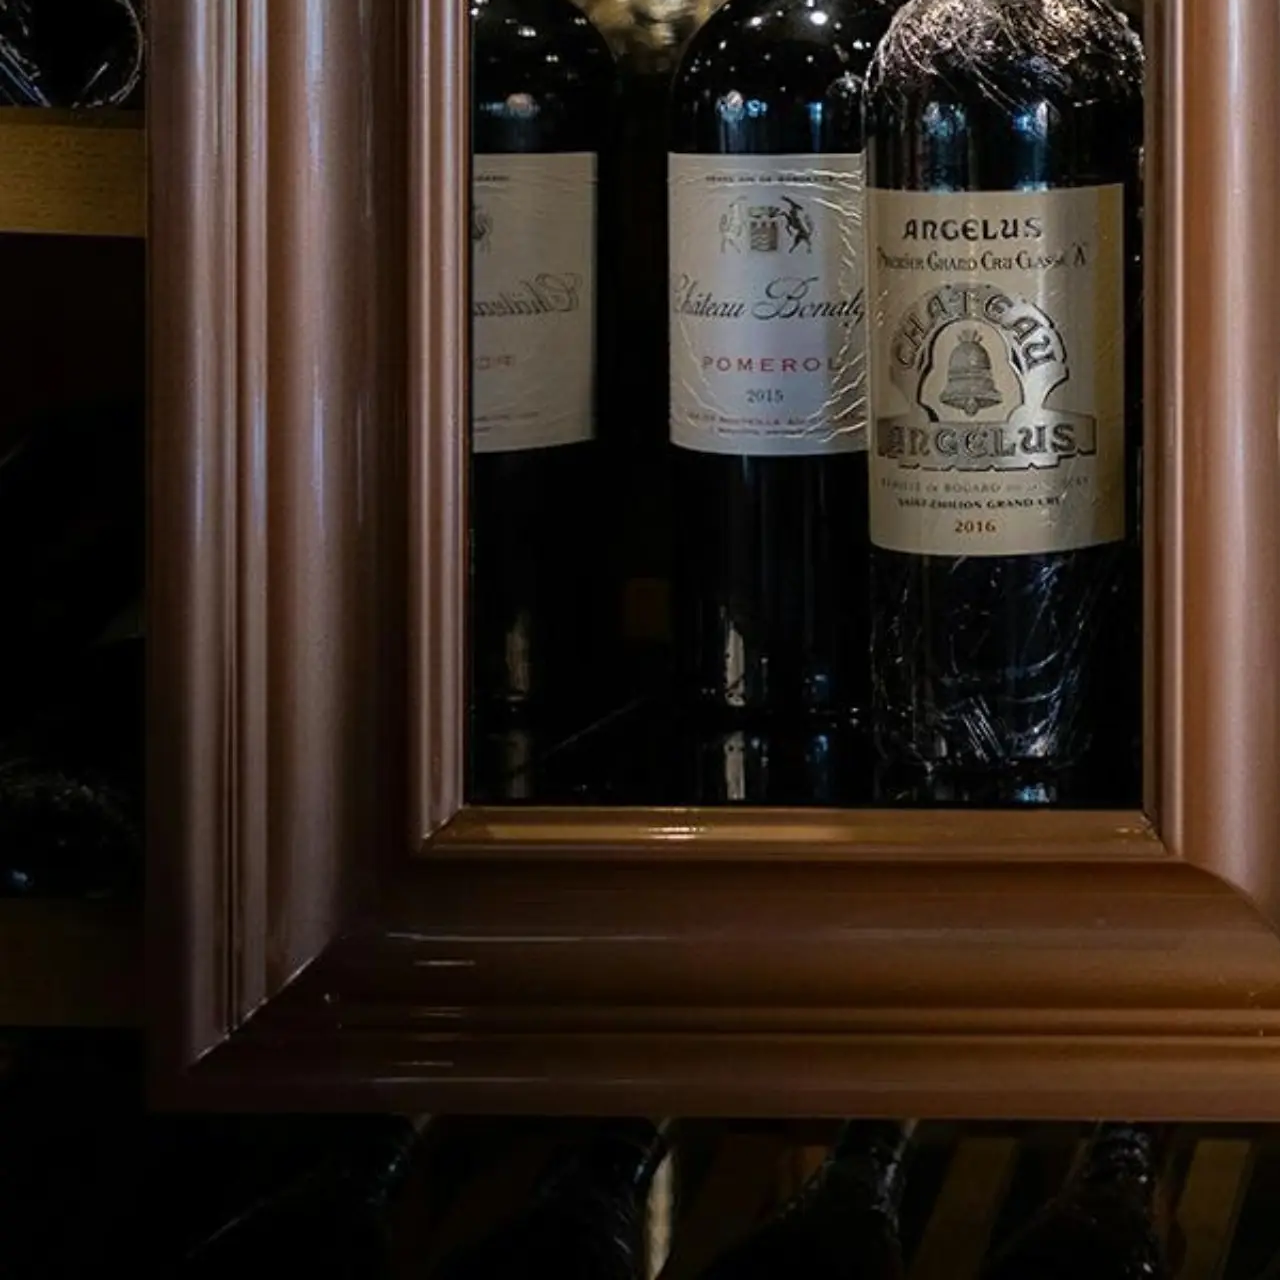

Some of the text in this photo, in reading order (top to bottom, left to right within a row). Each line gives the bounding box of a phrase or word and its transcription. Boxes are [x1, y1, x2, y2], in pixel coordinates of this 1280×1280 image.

[902, 217, 1043, 241] ANGELUS
[702, 356, 841, 372] POMEROL
[745, 388, 784, 404] 2015
[886, 422, 1076, 458] ANGELUS
[954, 520, 997, 533] 2016
